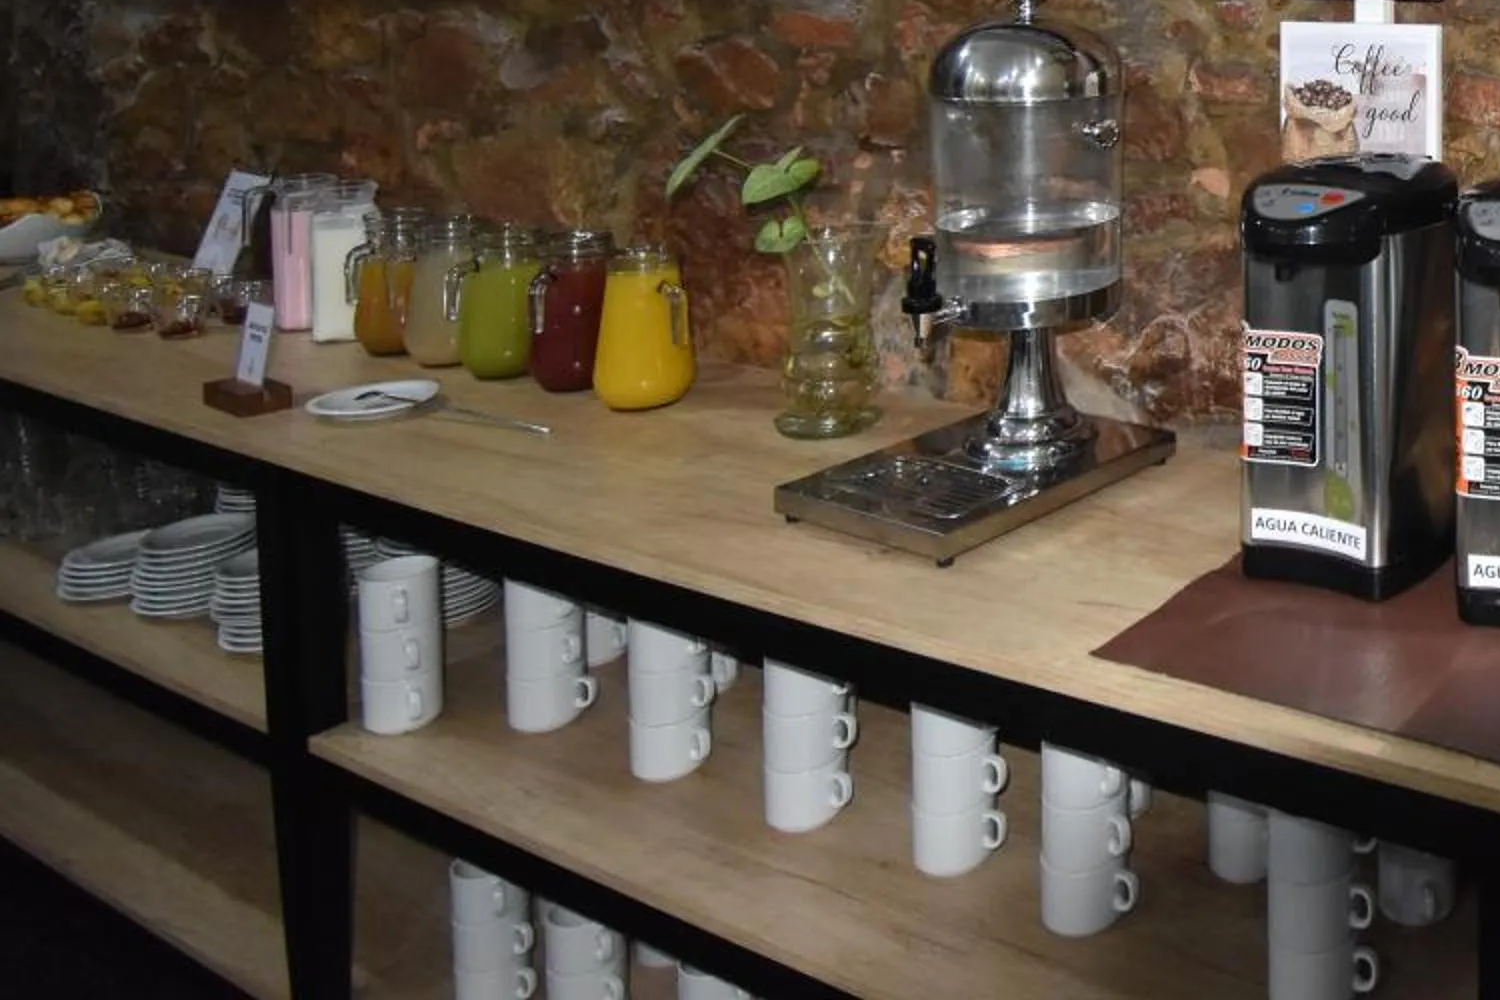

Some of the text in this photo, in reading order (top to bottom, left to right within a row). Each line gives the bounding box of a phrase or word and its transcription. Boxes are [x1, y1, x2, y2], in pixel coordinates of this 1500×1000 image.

[1332, 43, 1412, 96] Coffee
[1362, 90, 1422, 139] good
[1245, 335, 1318, 351] MODOS
[1255, 516, 1361, 550] AGUA CALIENTE
